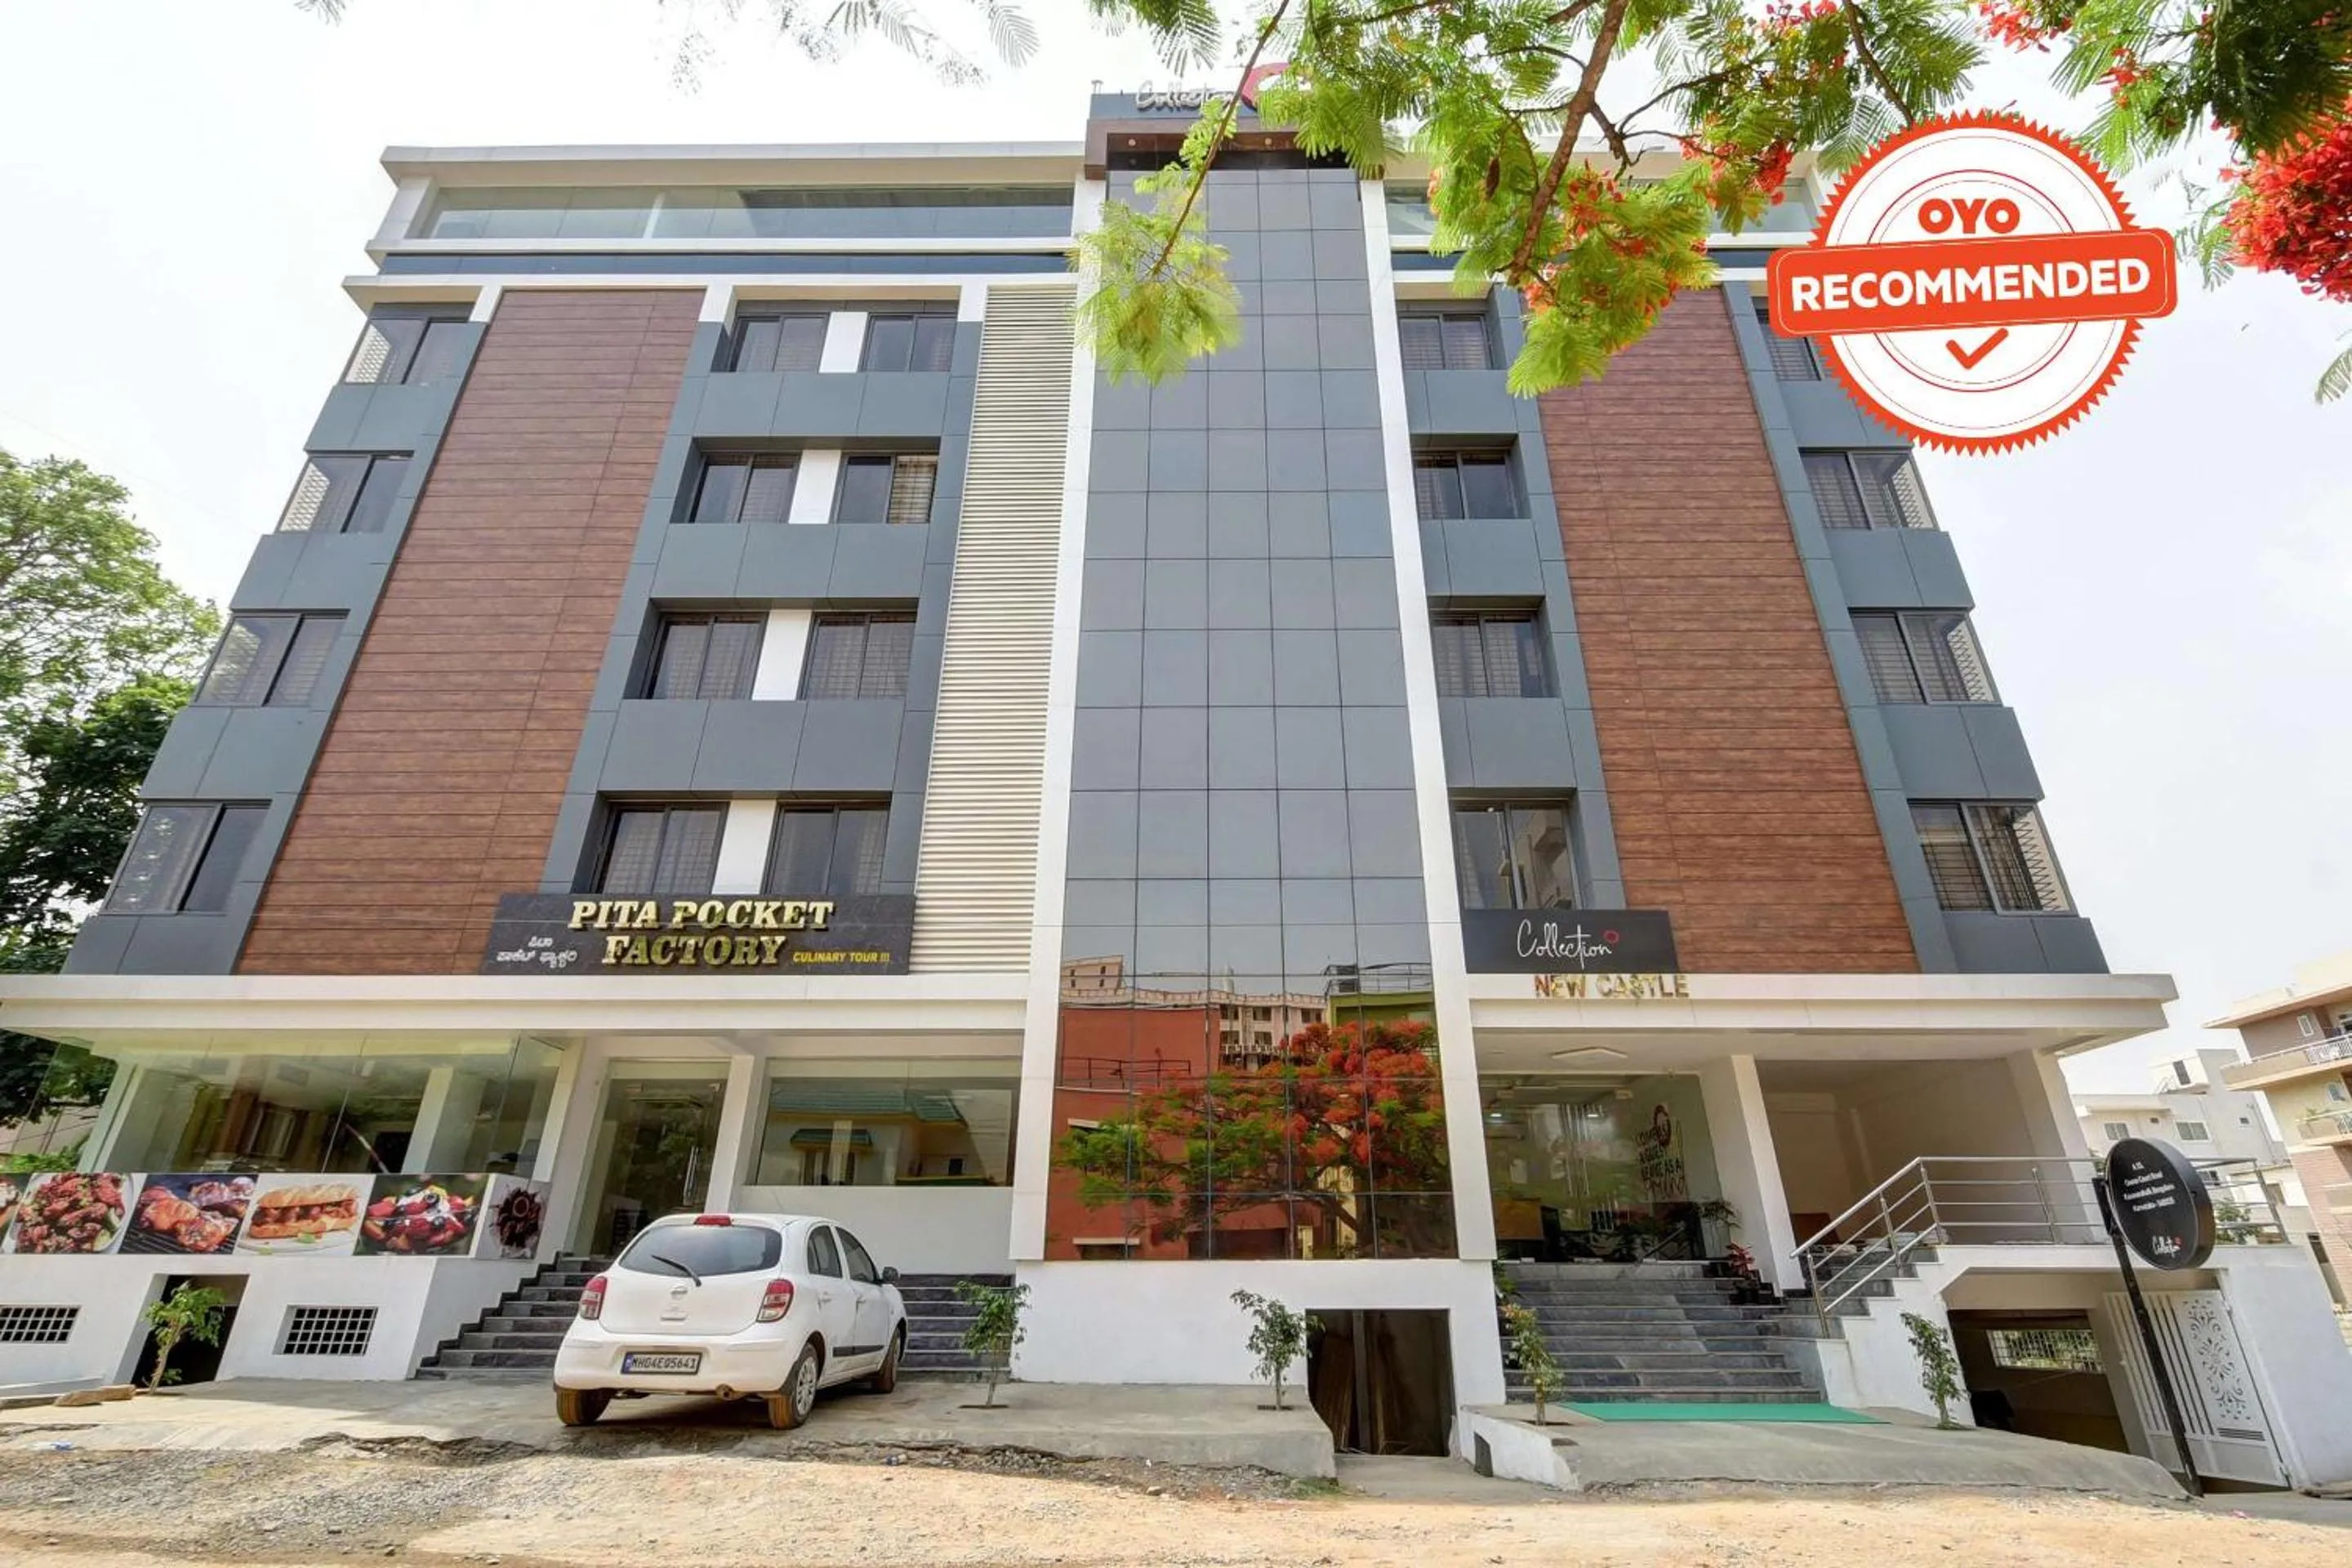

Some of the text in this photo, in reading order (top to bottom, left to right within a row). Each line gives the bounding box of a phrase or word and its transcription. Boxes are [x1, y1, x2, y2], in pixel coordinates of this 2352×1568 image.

[568, 900, 834, 930] PITA POCKET
[602, 935, 786, 966] FACTORY
[793, 951, 846, 963] CULINARY
[850, 951, 877, 963] TOUR
[1517, 918, 1612, 970] Collection
[1534, 973, 1690, 998] NEW CASTLE
